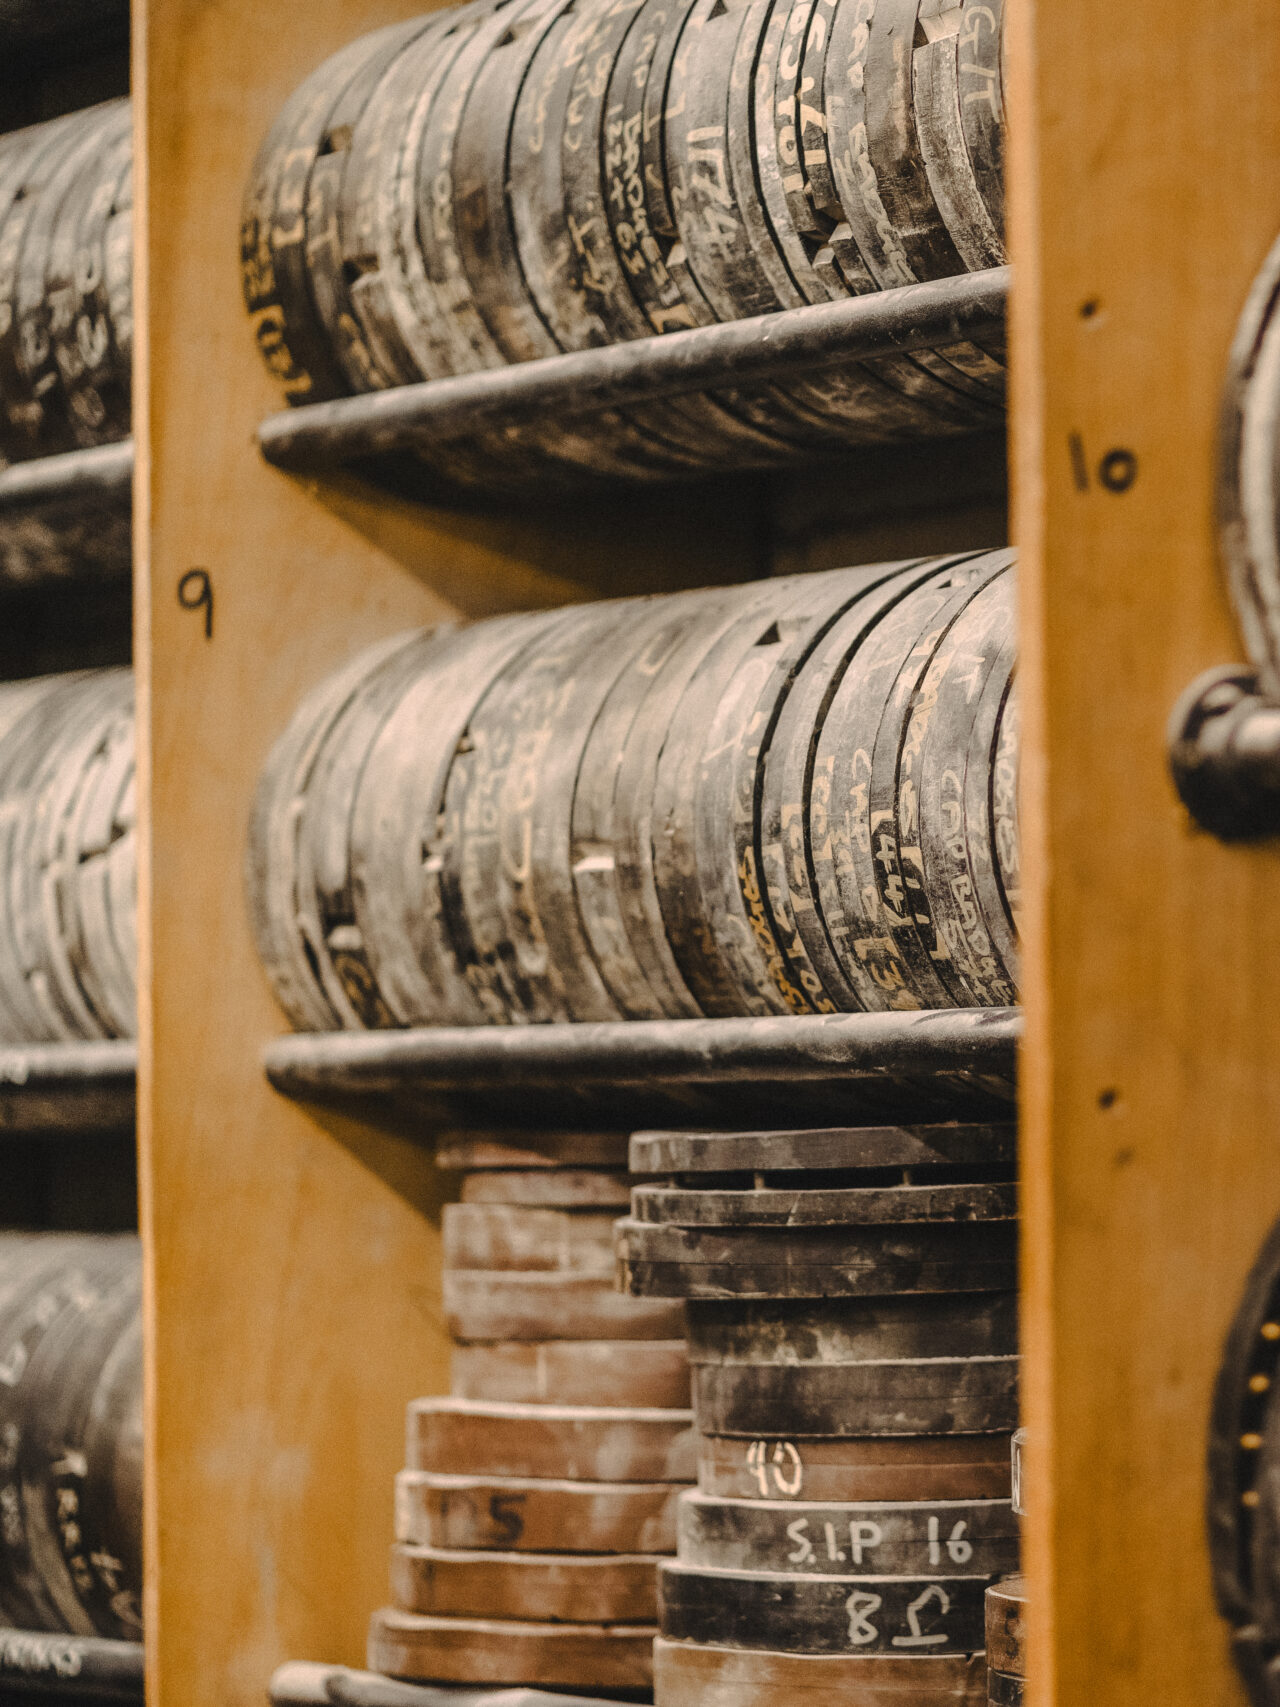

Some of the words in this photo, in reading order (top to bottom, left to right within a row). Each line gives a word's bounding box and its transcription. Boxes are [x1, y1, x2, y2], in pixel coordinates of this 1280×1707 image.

[1067, 430, 1138, 496] 10
[178, 570, 213, 638] 9
[927, 1515, 973, 1566] 16
